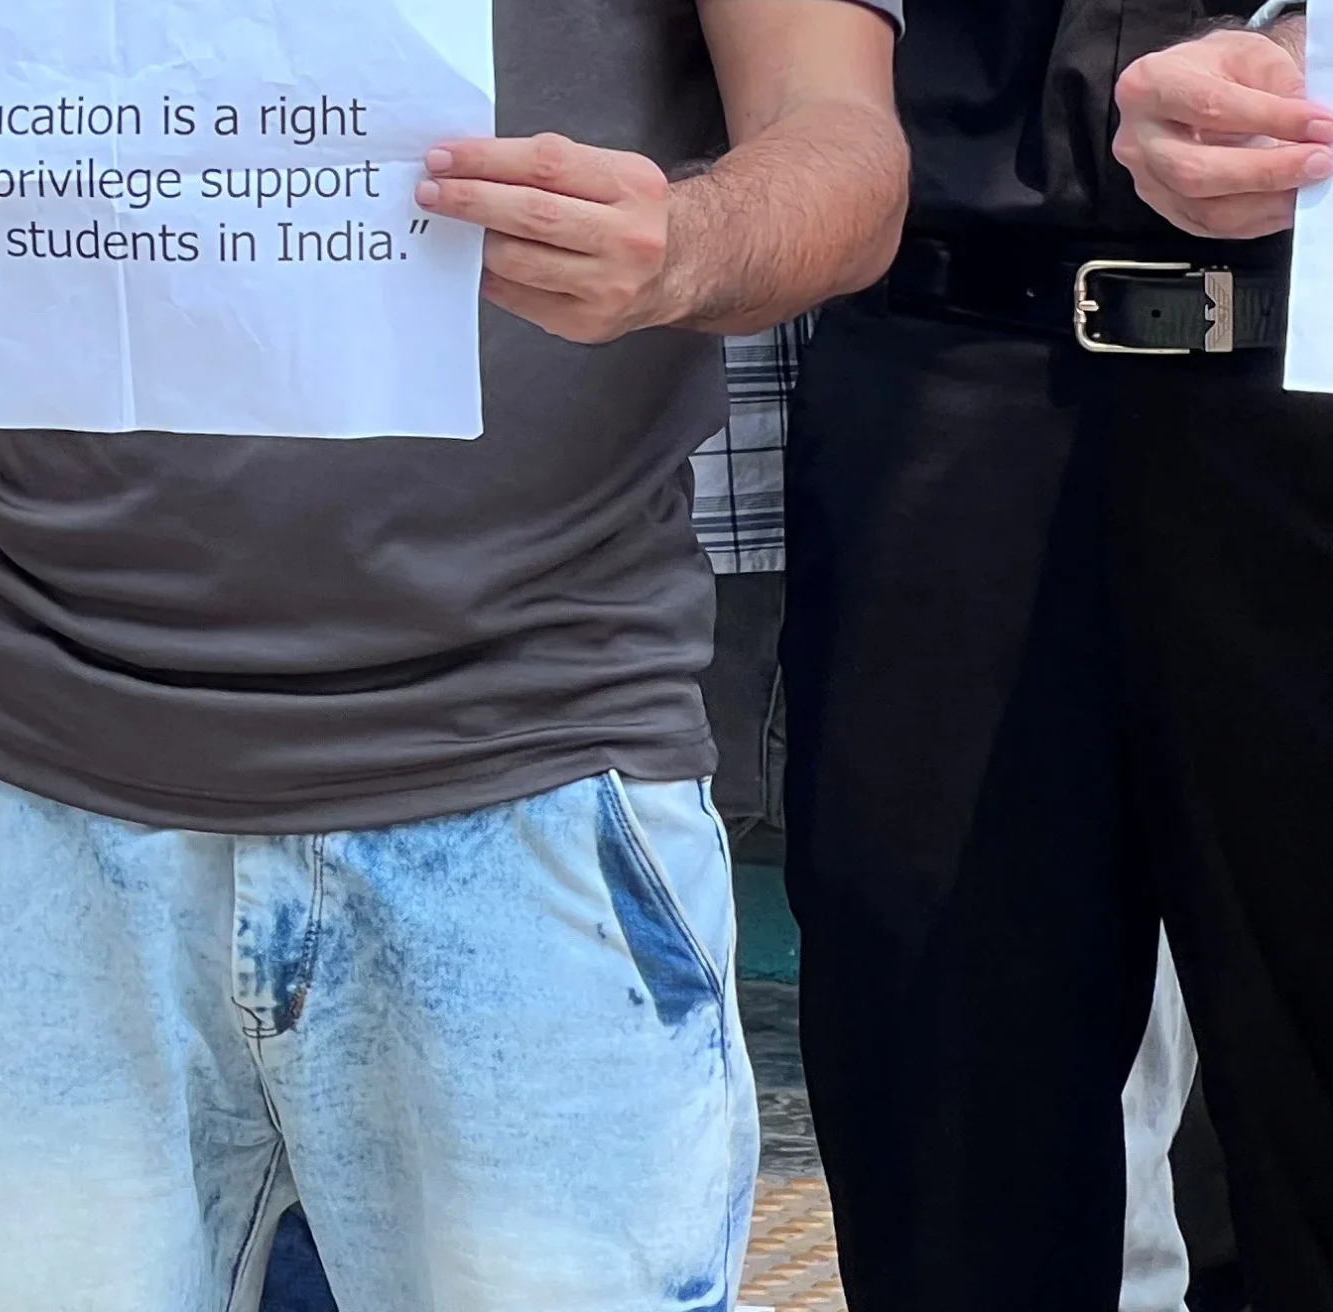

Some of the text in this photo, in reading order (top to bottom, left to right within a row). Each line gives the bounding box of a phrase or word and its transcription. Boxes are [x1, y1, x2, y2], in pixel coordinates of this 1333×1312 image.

[163, 94, 196, 136] is
[214, 104, 239, 137] a
[260, 94, 368, 146] right
[200, 159, 380, 209] support
[6, 219, 200, 263] students
[219, 222, 256, 263] in
[276, 218, 430, 262] India.”
